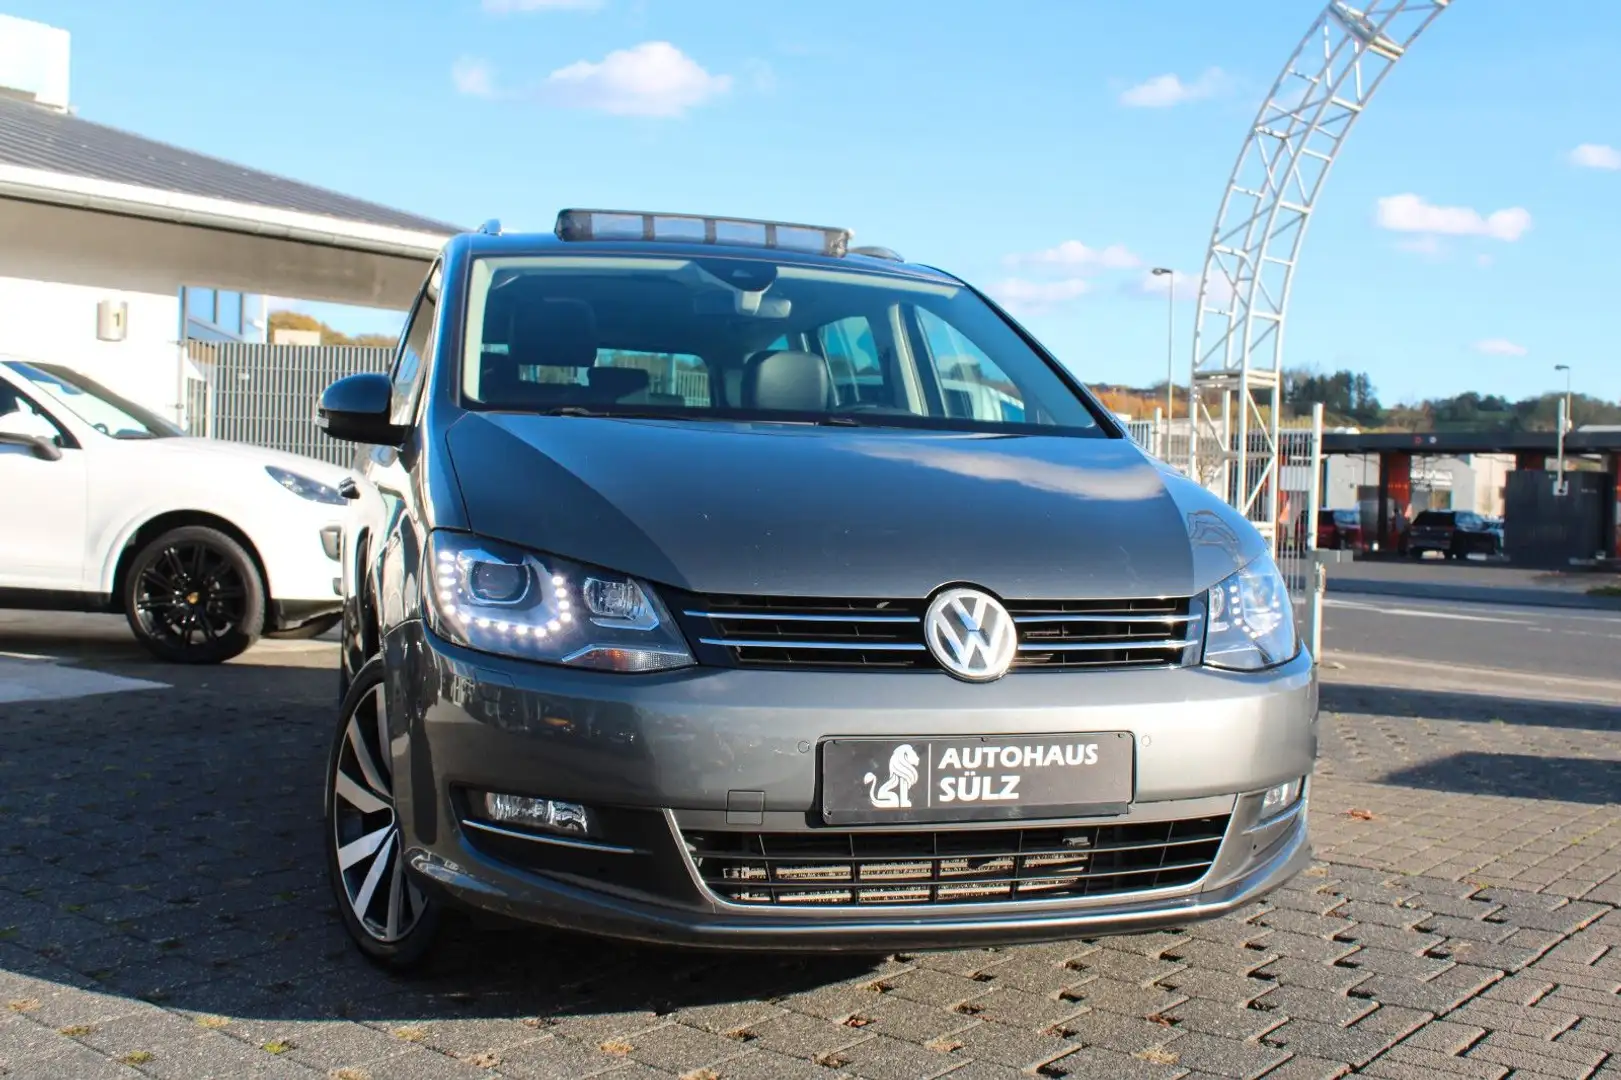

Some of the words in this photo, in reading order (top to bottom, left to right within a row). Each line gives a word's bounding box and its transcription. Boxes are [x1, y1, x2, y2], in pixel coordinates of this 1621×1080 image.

[929, 592, 1012, 676] VW
[938, 743, 1098, 769] AUTOHAUS
[939, 771, 1020, 802] SÜLZ
